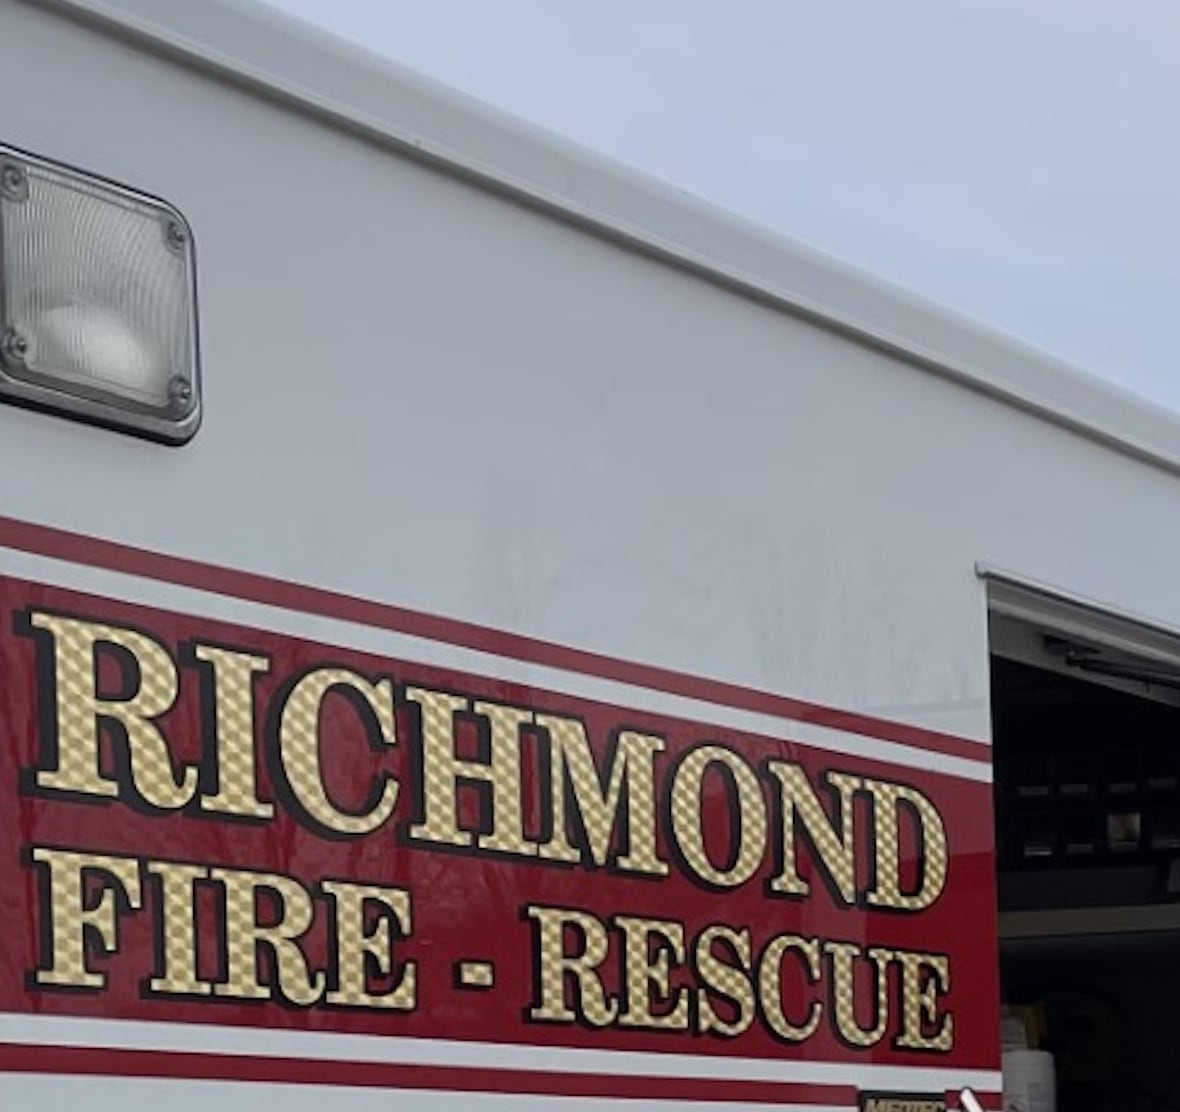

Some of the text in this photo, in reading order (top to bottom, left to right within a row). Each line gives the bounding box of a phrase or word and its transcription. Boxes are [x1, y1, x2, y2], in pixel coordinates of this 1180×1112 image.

[24, 607, 951, 913] RICHMOND
[28, 847, 418, 1012] FIRE
[523, 903, 956, 1055] RESCUE
